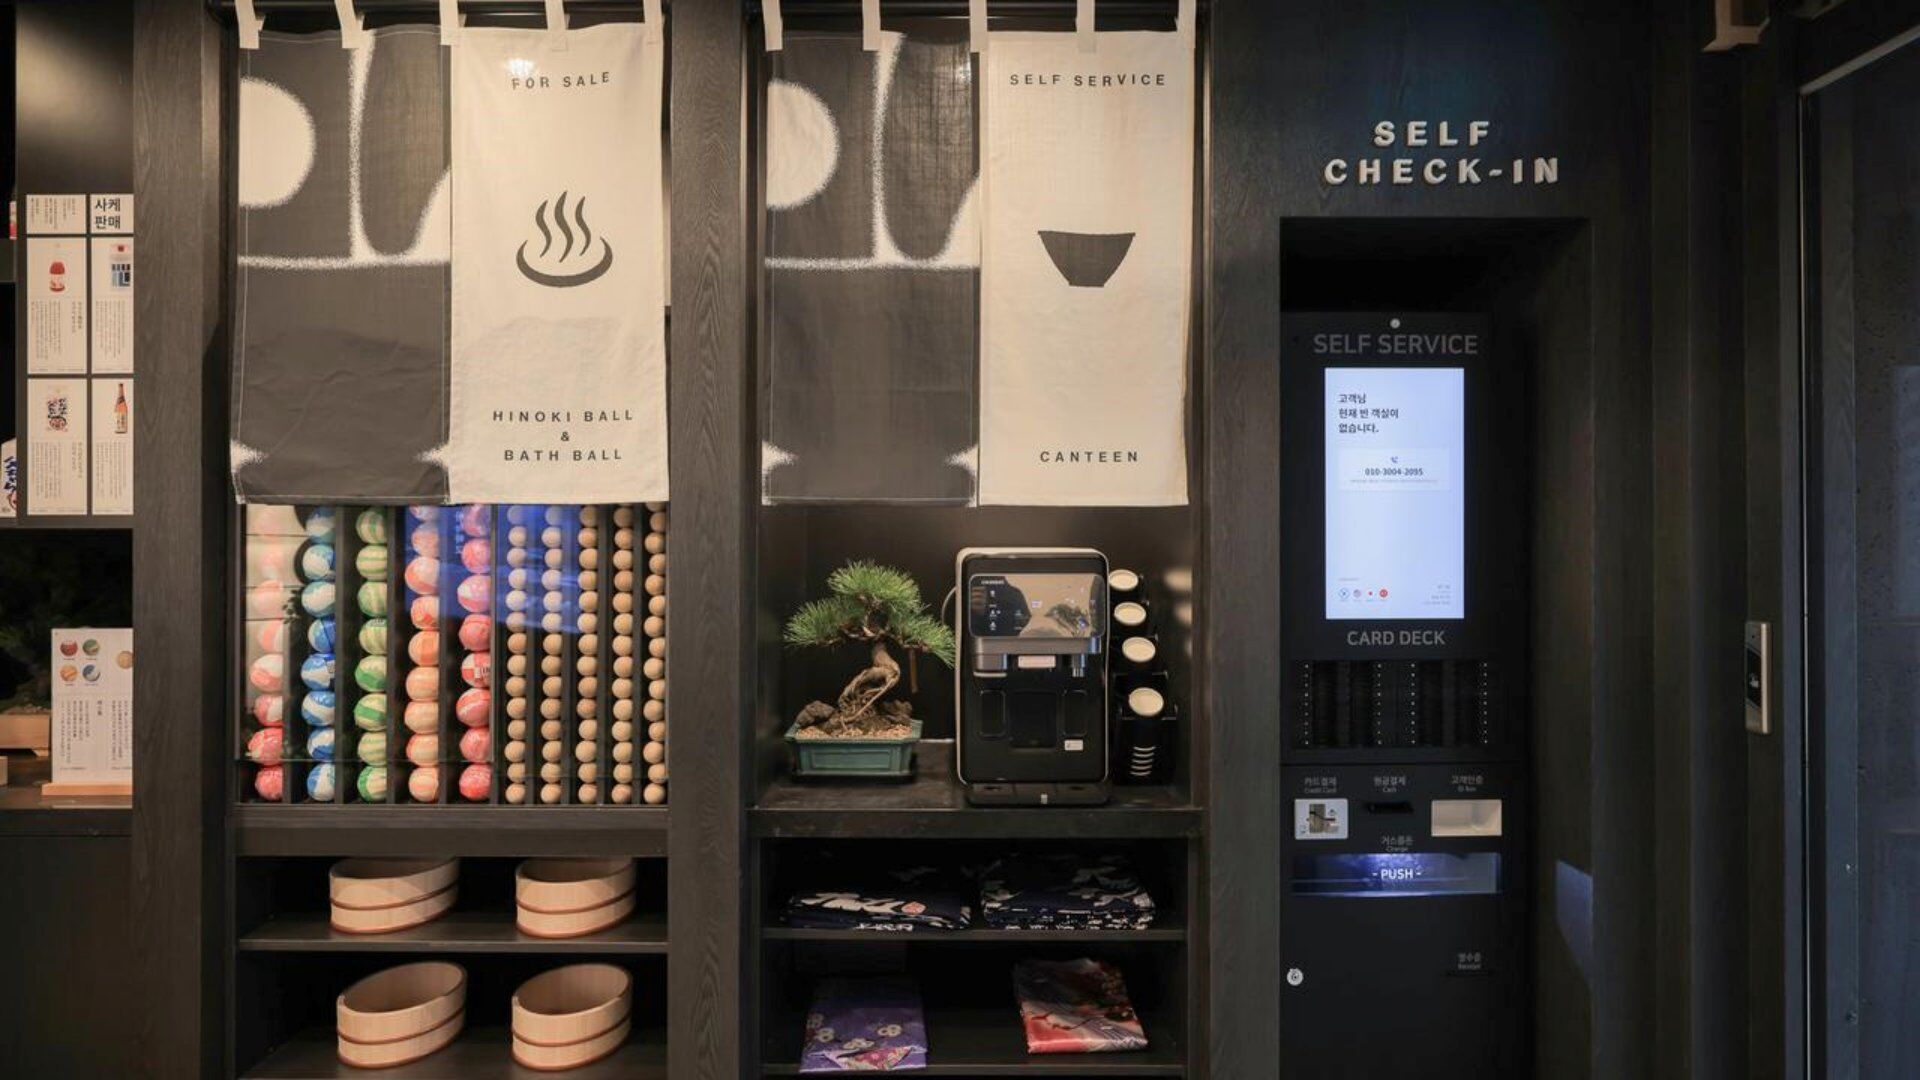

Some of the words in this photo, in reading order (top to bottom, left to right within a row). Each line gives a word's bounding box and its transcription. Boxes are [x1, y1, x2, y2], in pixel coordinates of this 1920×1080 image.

[511, 76, 550, 90] FOR
[562, 71, 610, 88] SALE
[1010, 74, 1063, 86] SELF
[1073, 73, 1166, 87] SERVICE
[1373, 120, 1490, 147] SELF
[1323, 157, 1560, 185] CHECK-IN
[95, 197, 121, 212] 사케
[95, 215, 121, 229] 판매
[1313, 333, 1371, 355] SELF
[1378, 333, 1479, 355] SERVICE
[1338, 392, 1366, 404] 고객님
[492, 410, 571, 422] HINOKI
[584, 409, 633, 422] BALL
[1338, 408, 1357, 419] 현재
[1371, 408, 1399, 419] 객실이
[1338, 422, 1379, 434] 없습니다.
[560, 431, 570, 442] &
[504, 449, 559, 461] BATH
[572, 448, 622, 461] BALL
[1040, 450, 1139, 463] CANTEEN
[1346, 630, 1395, 646] CARD
[1399, 630, 1446, 646] DECK
